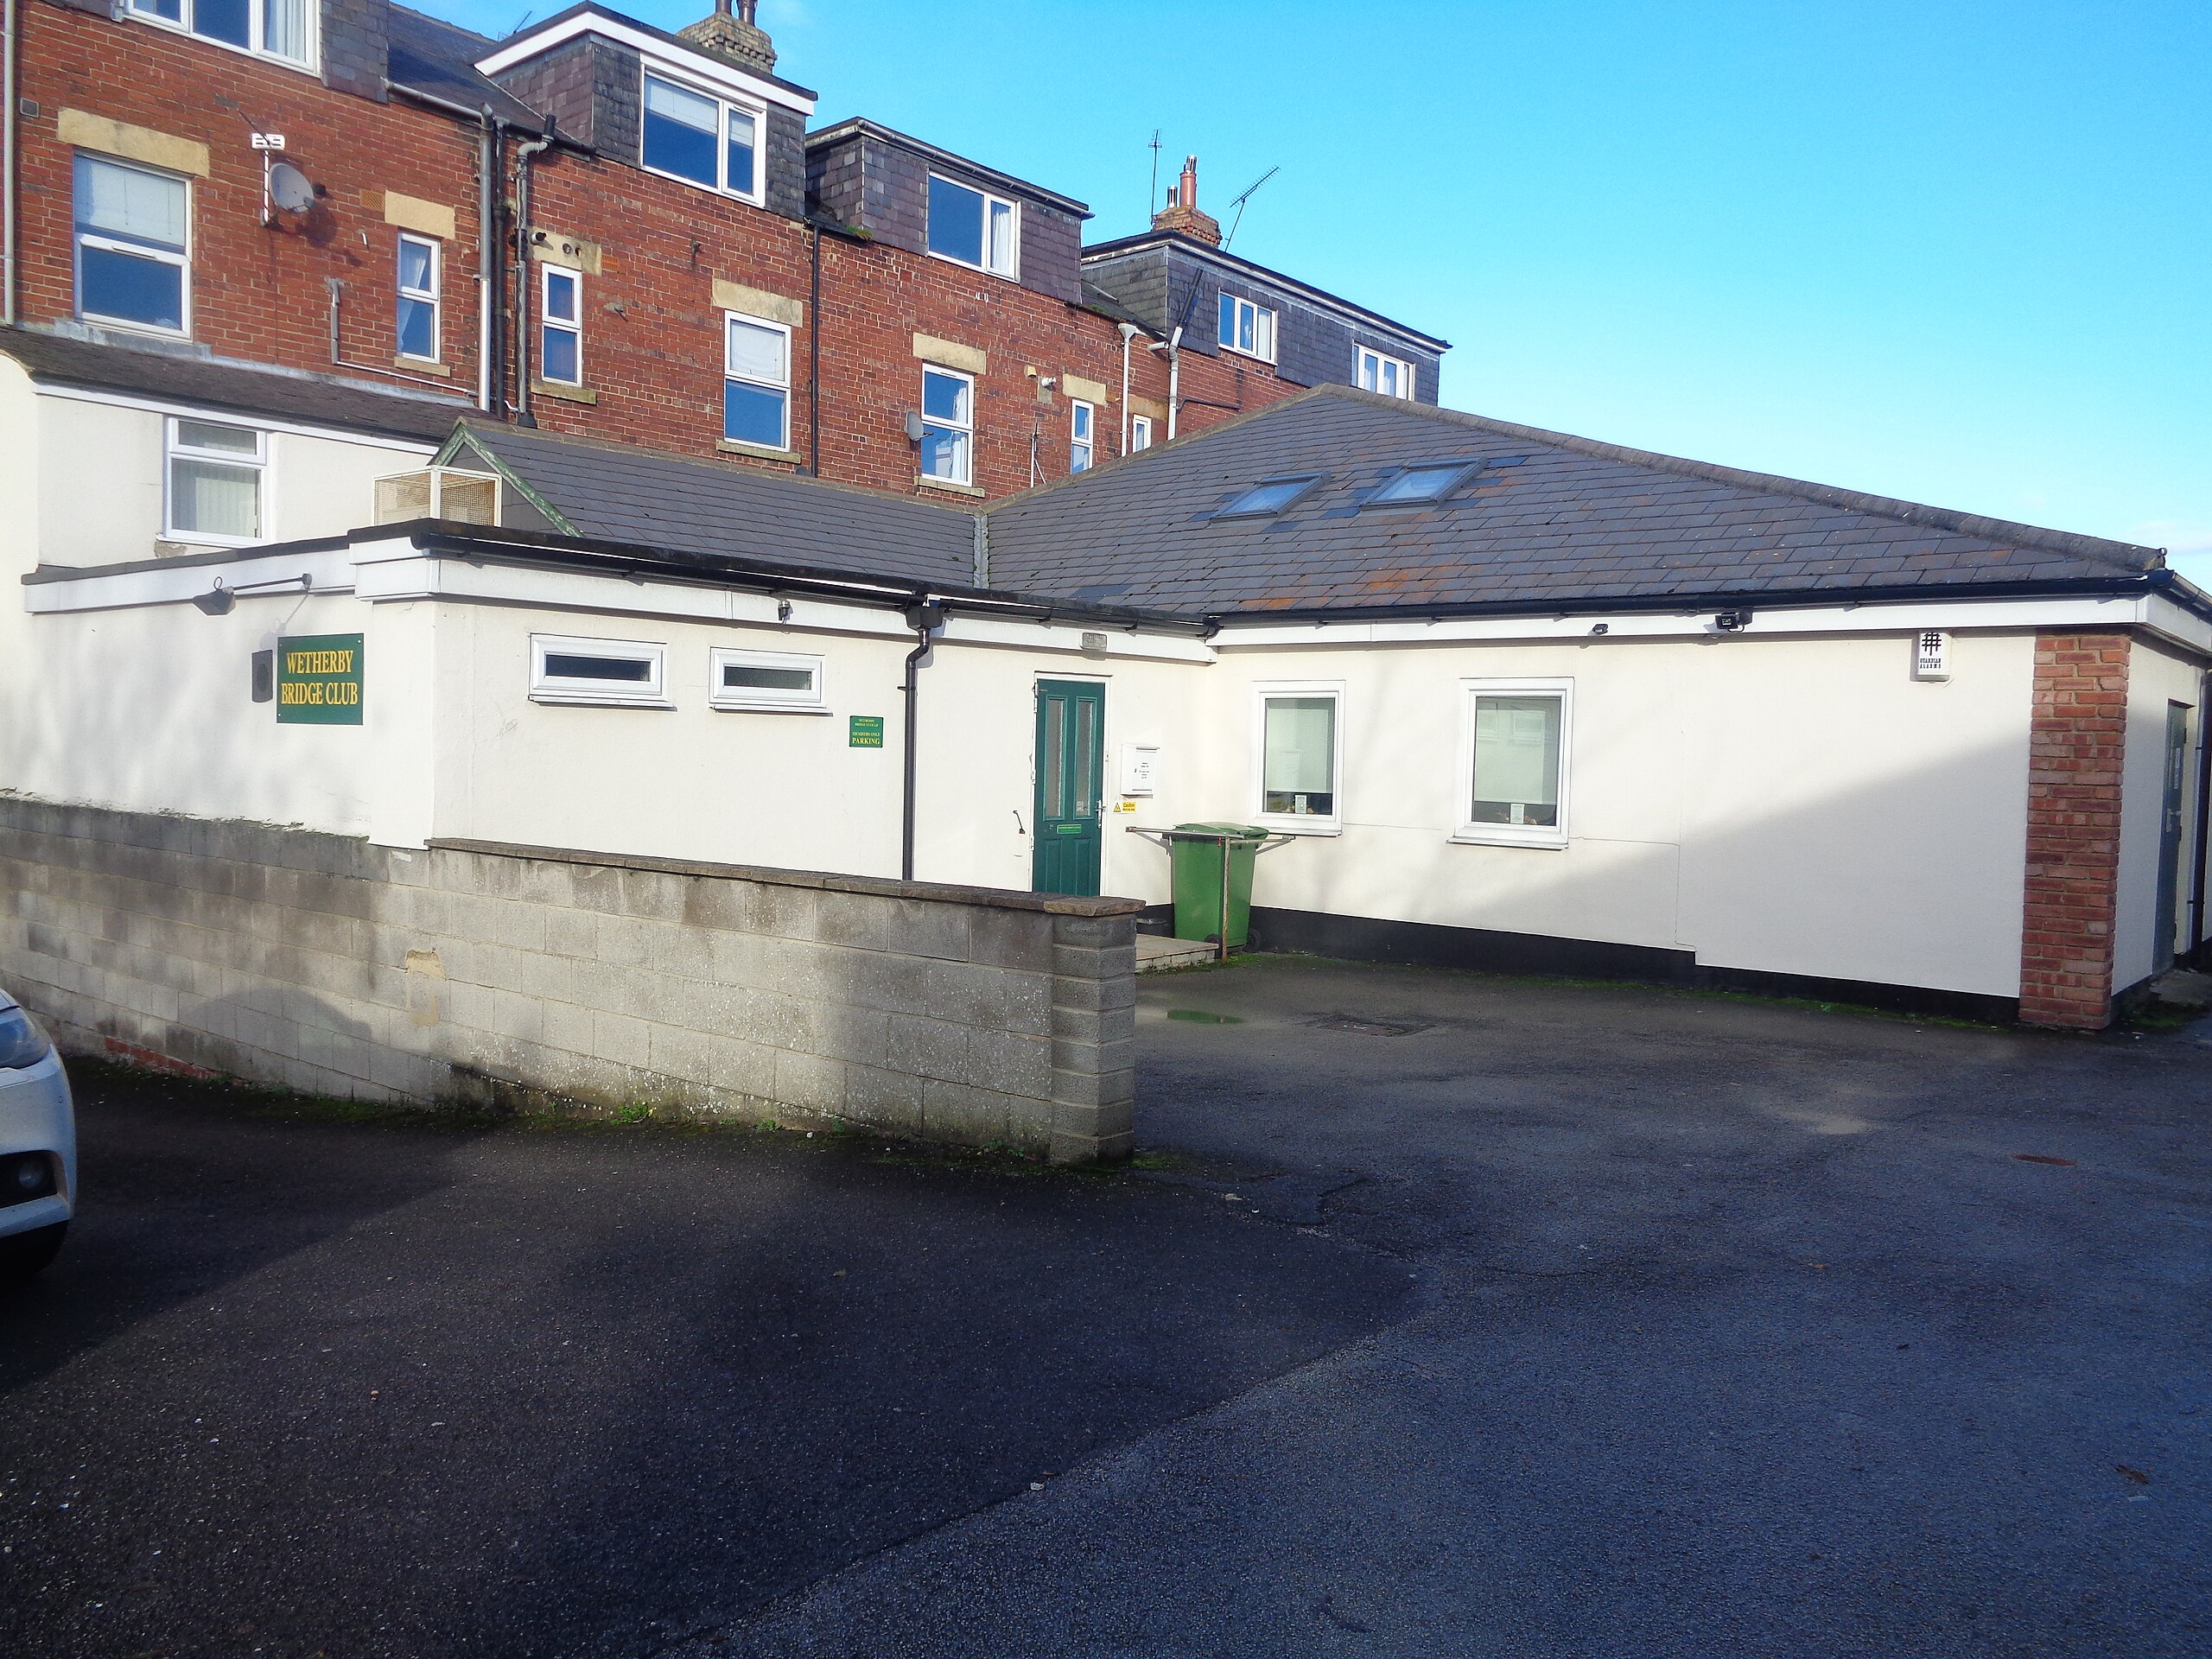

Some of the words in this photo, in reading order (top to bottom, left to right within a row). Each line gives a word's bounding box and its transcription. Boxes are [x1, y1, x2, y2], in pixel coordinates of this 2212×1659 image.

[286, 650, 353, 674] WETHERBY
[281, 682, 323, 705] BRIDGE
[325, 682, 359, 705] CLUB
